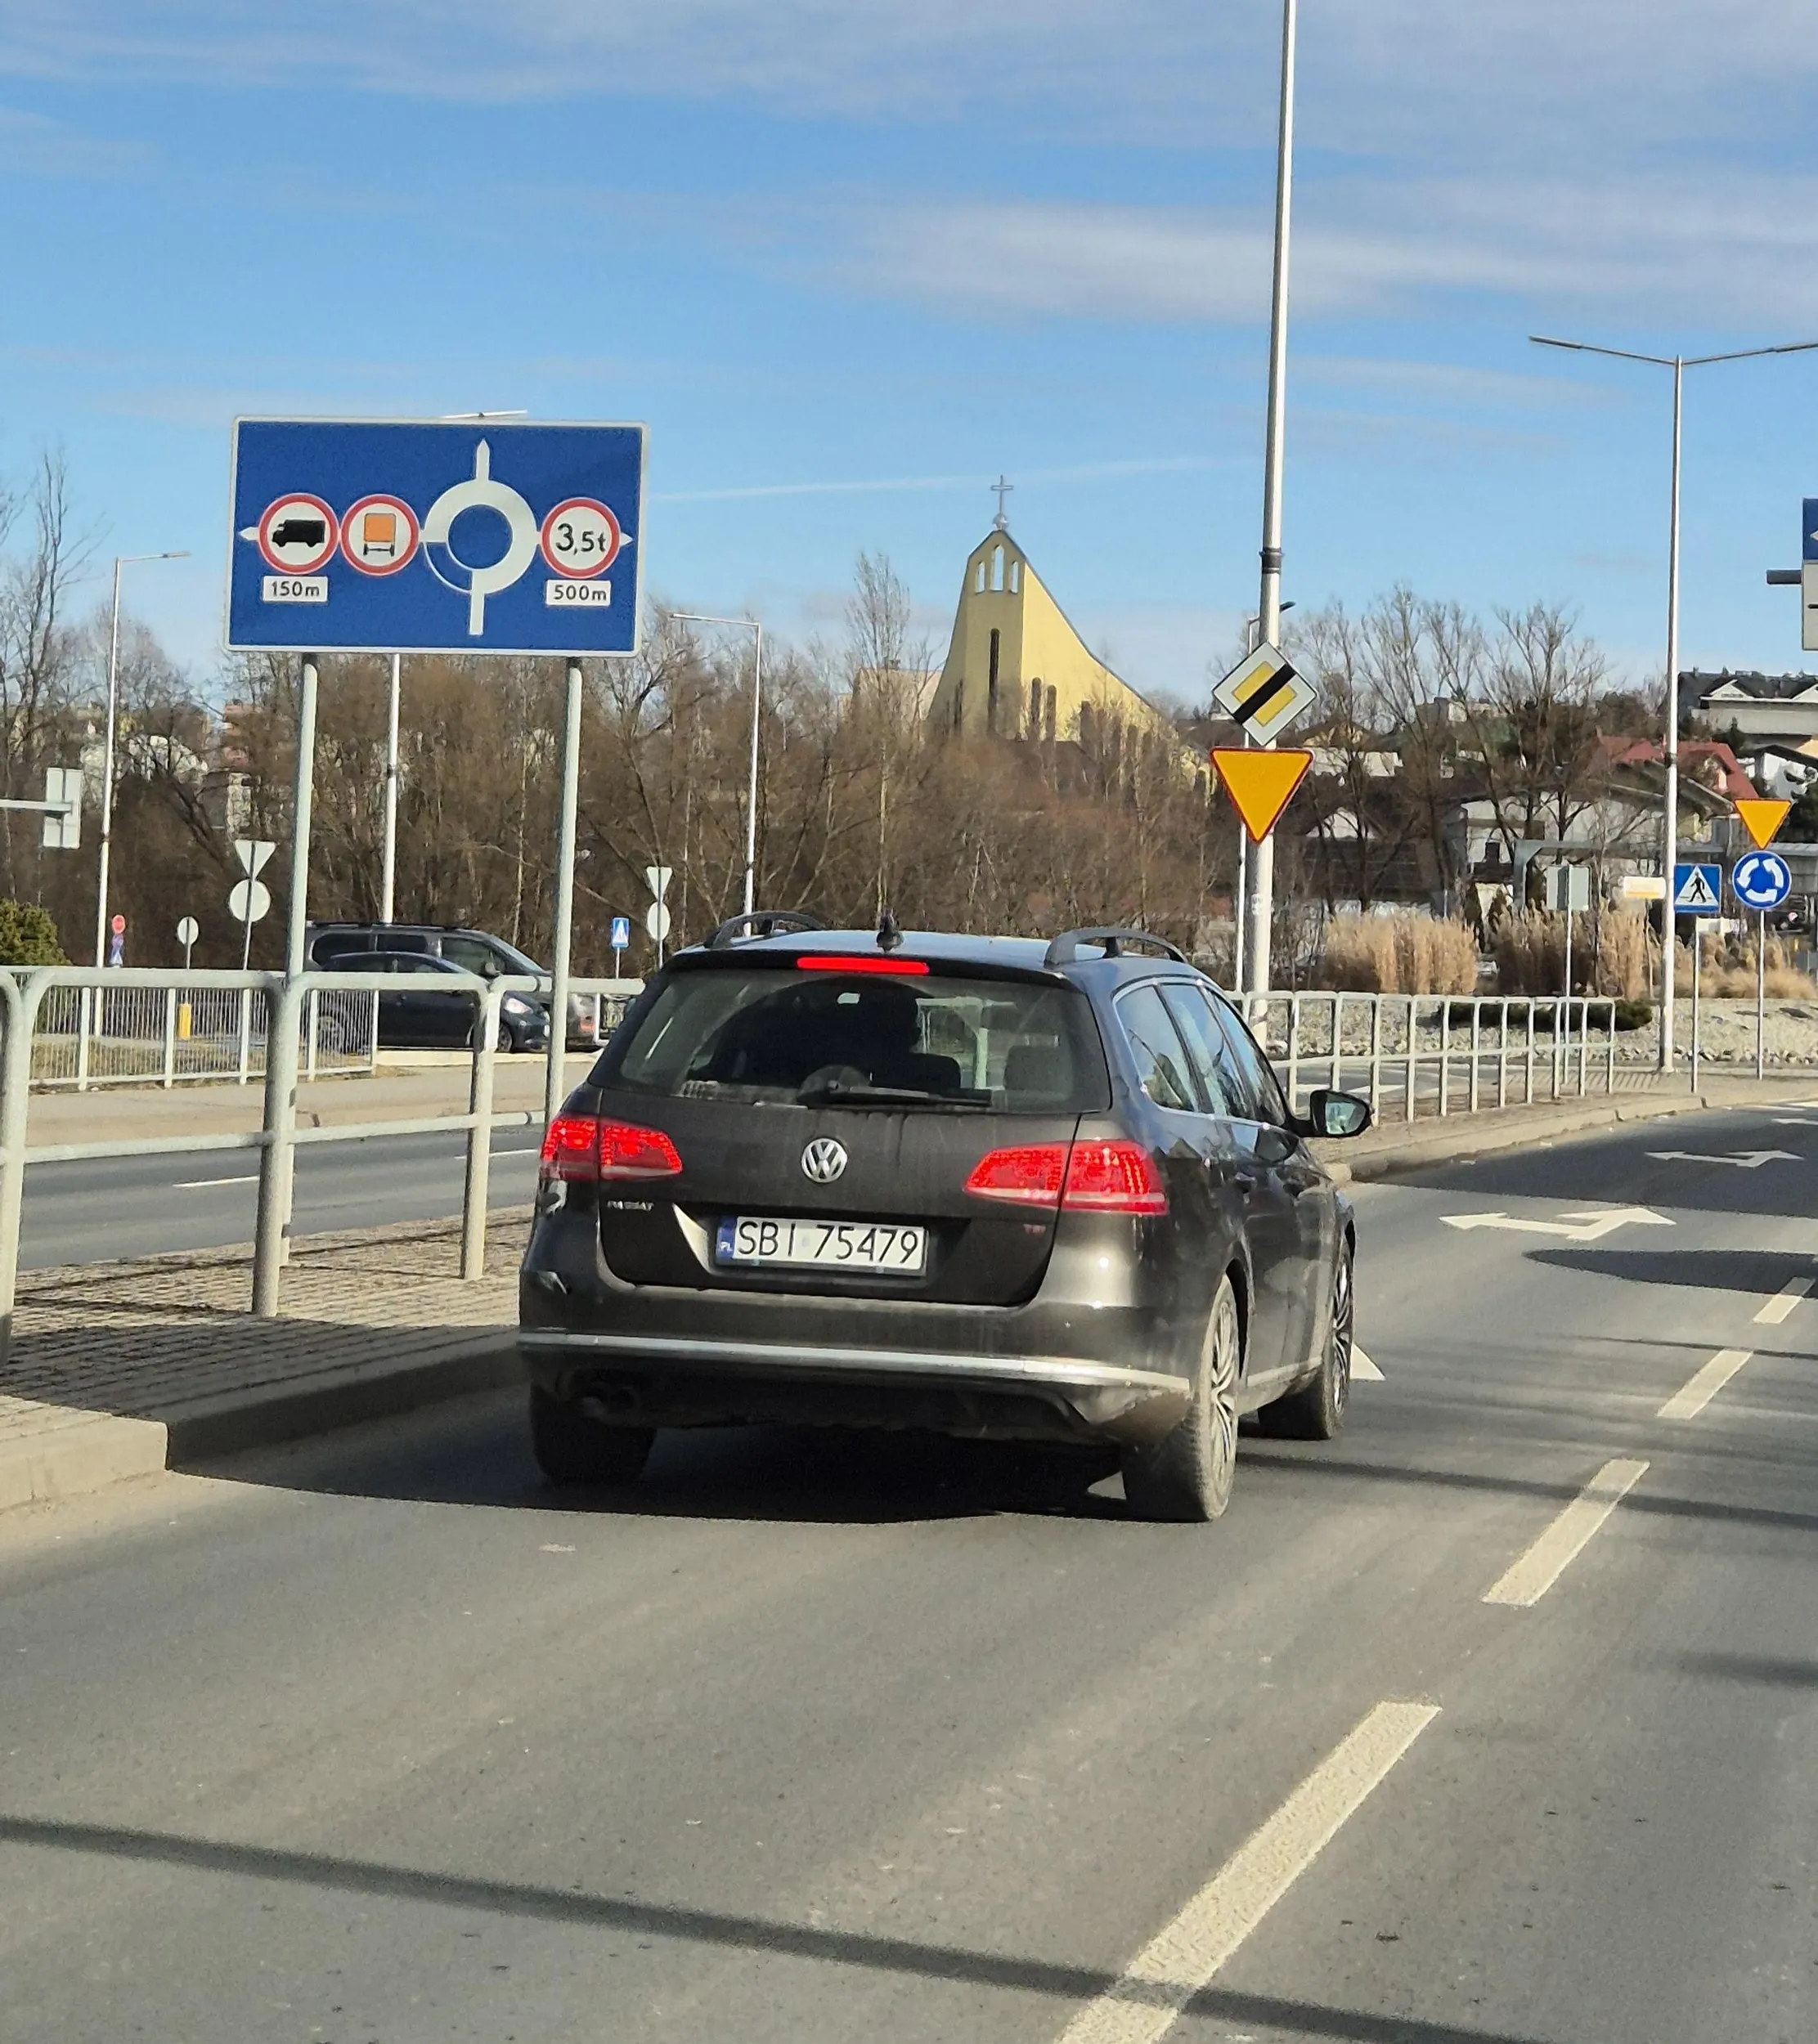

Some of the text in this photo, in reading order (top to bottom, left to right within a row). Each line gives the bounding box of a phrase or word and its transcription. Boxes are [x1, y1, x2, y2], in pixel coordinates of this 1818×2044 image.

[556, 522, 606, 555] 3,5t
[272, 580, 320, 596] 150m
[554, 585, 606, 601] 500m
[738, 1221, 918, 1264] SBI 75479
